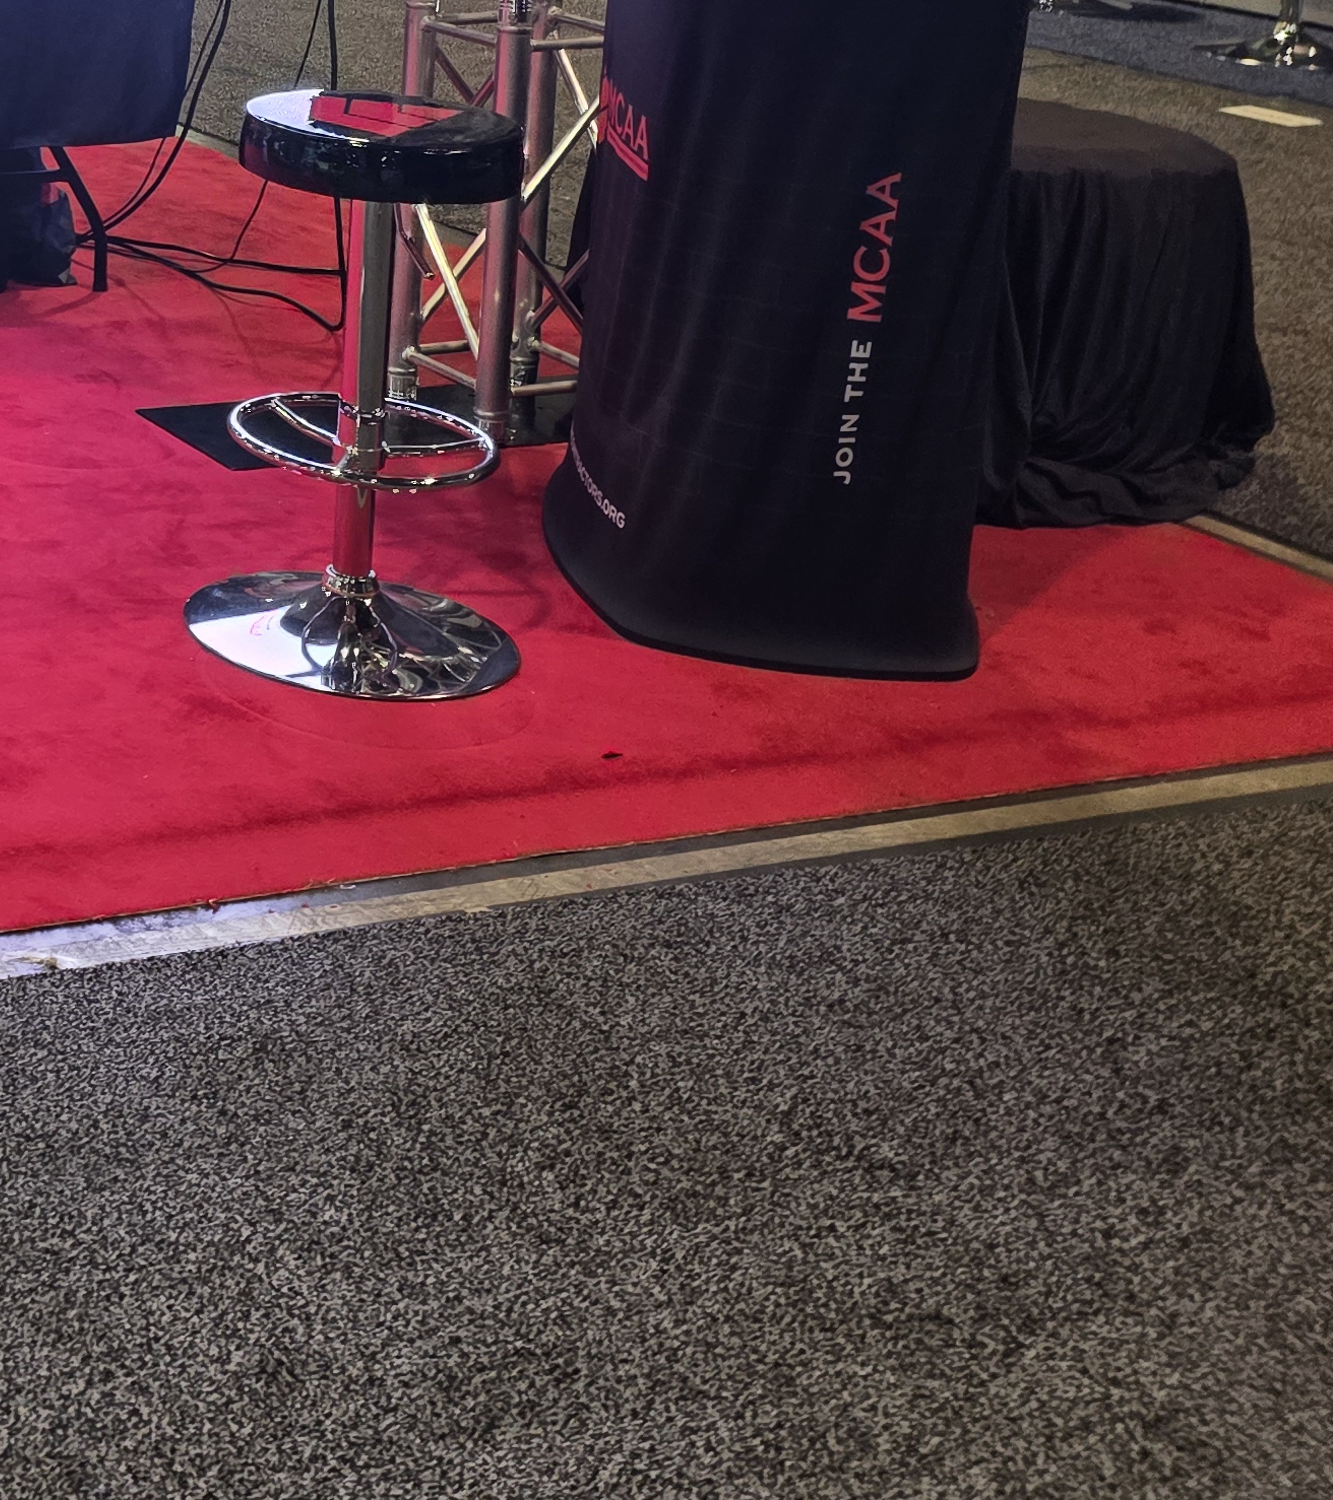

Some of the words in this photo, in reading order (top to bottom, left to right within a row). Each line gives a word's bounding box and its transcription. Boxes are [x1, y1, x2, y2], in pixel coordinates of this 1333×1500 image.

[607, 78, 649, 161] MCAA
[845, 172, 902, 324] MCAA
[844, 339, 873, 404] THE
[833, 414, 862, 486] JOIN
